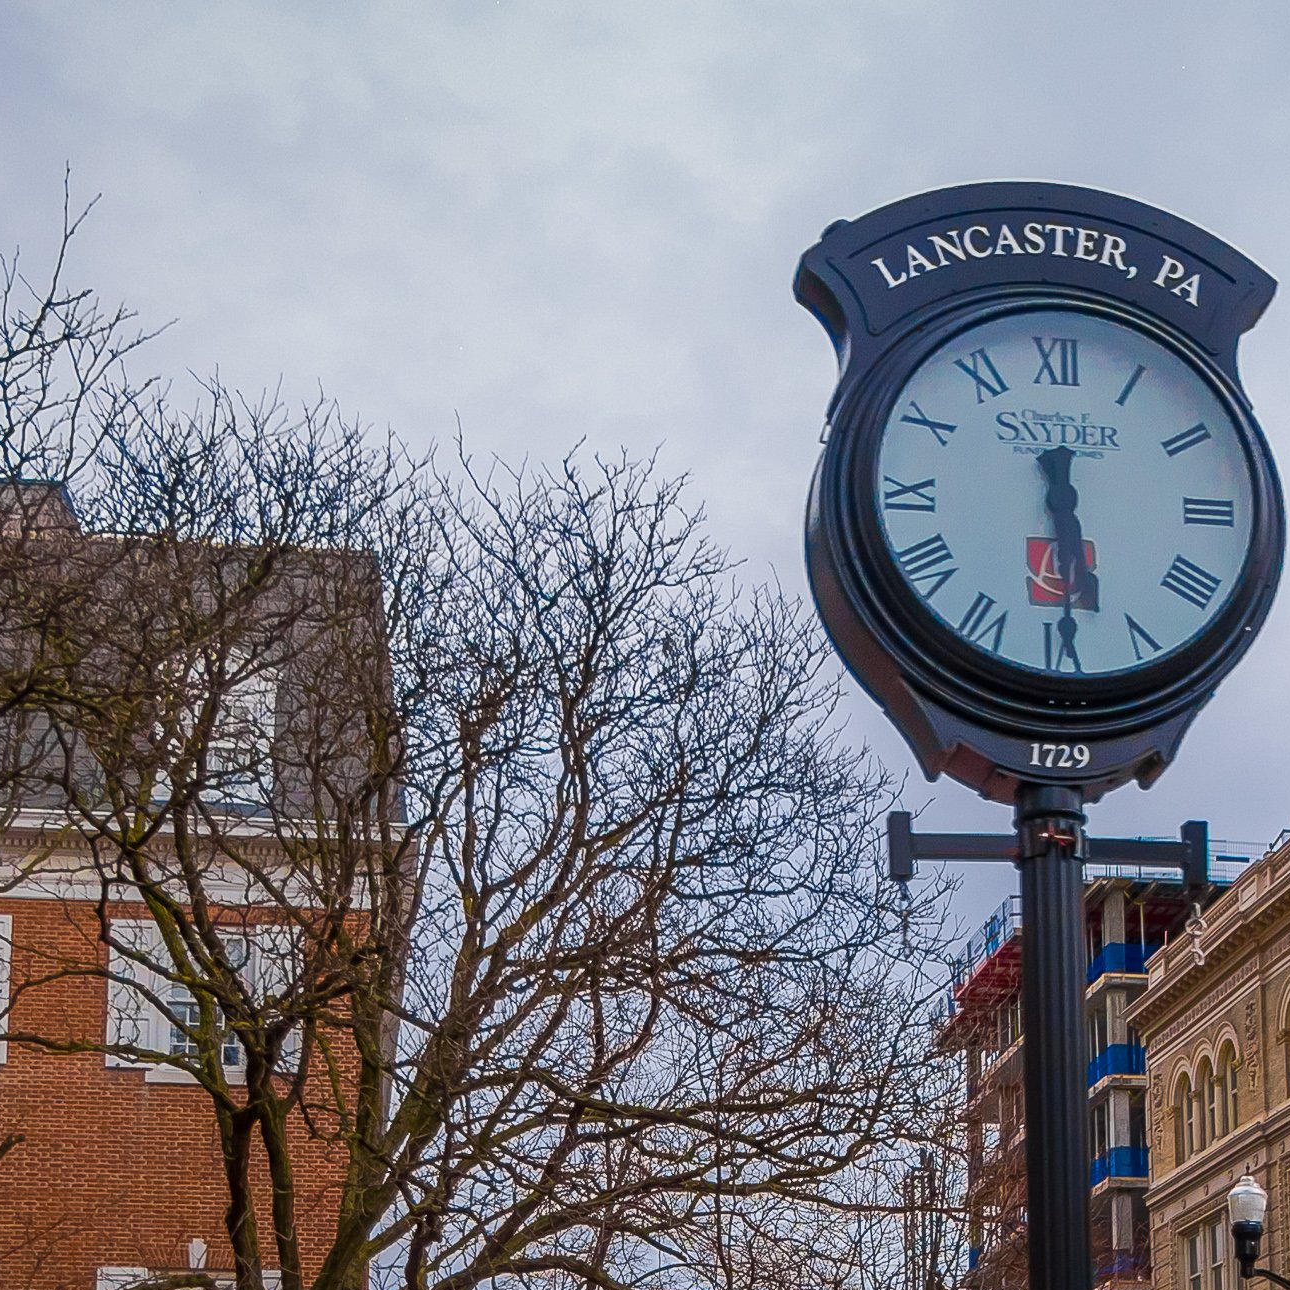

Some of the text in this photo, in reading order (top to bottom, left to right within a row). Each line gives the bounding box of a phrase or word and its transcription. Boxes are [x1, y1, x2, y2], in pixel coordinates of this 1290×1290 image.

[871, 222, 1202, 307] LANCASTER, PA
[953, 347, 1010, 404] XI
[1032, 336, 1080, 386] XII
[995, 411, 1119, 447] SNYDER
[1029, 743, 1091, 768] 1729
